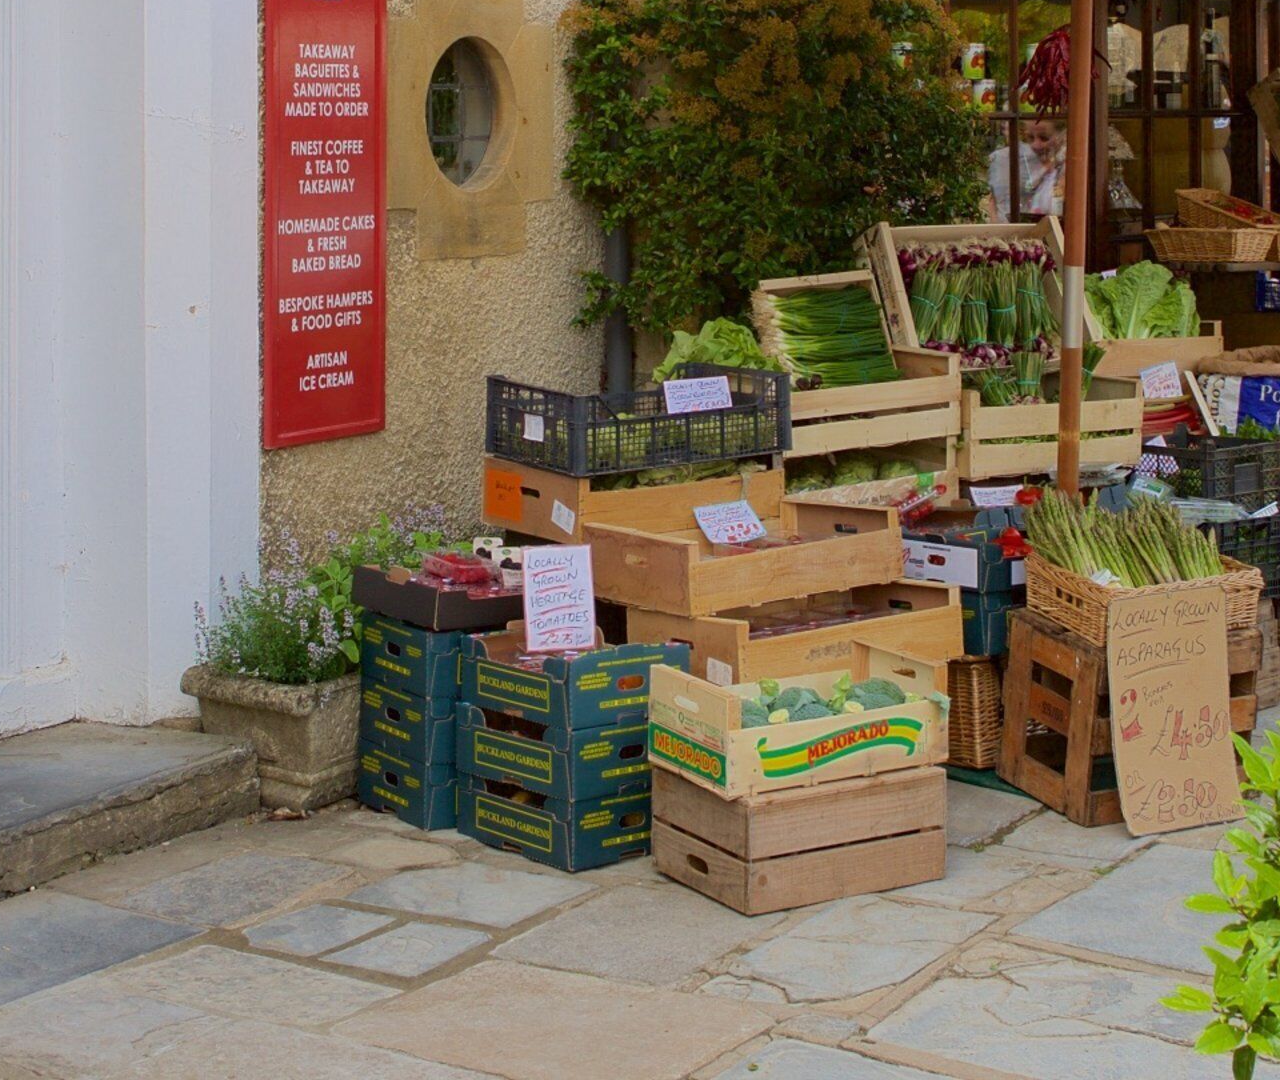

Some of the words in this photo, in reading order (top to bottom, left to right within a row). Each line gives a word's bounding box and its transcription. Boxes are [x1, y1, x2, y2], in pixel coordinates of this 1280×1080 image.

[299, 43, 355, 59] TAKEAWAY
[294, 63, 350, 78] BAGUETTES
[352, 64, 359, 78] &
[293, 82, 361, 97] SANDWICHES
[285, 102, 317, 117] MADE
[320, 102, 332, 116] TO
[335, 102, 369, 117] ORDER
[291, 140, 323, 156] FINEST
[325, 140, 363, 155] COFFEE
[305, 161, 313, 175] &
[315, 160, 334, 175] TEA
[336, 159, 349, 174] TO
[299, 178, 355, 194] TAKEAWAY
[278, 217, 340, 235] HOMEMADE
[342, 215, 375, 231] CAKES
[307, 238, 314, 252] &
[317, 236, 347, 251] FRESH
[292, 257, 326, 273] BAKED
[329, 254, 361, 270] BREAD
[279, 294, 324, 313] BESPOKE
[326, 290, 373, 308] HAMPERS
[291, 318, 299, 332] &
[301, 314, 332, 331] FOOD
[335, 311, 362, 327] GIFTS
[306, 351, 347, 370] ARTISAN
[299, 375, 316, 391] ICE
[319, 371, 354, 388] CREAM
[527, 554, 574, 569] LOCALLY
[533, 569, 578, 588] GROWN
[530, 589, 587, 608] HERITAGE
[530, 610, 589, 629] TOMATOES
[1113, 606, 1169, 631] LOCALLY
[1173, 600, 1220, 626] GROWN
[1117, 635, 1207, 666] ASPARAGUS
[479, 675, 515, 693] BUCKLAND
[516, 684, 549, 700] GARDENS
[807, 720, 890, 767] MEJORADO
[476, 743, 516, 763] BUCKLAND
[517, 754, 551, 770] GARDENS
[653, 729, 722, 778] MEJORADO
[477, 809, 516, 830] BUCKLAND
[517, 822, 551, 840] GARDENS
